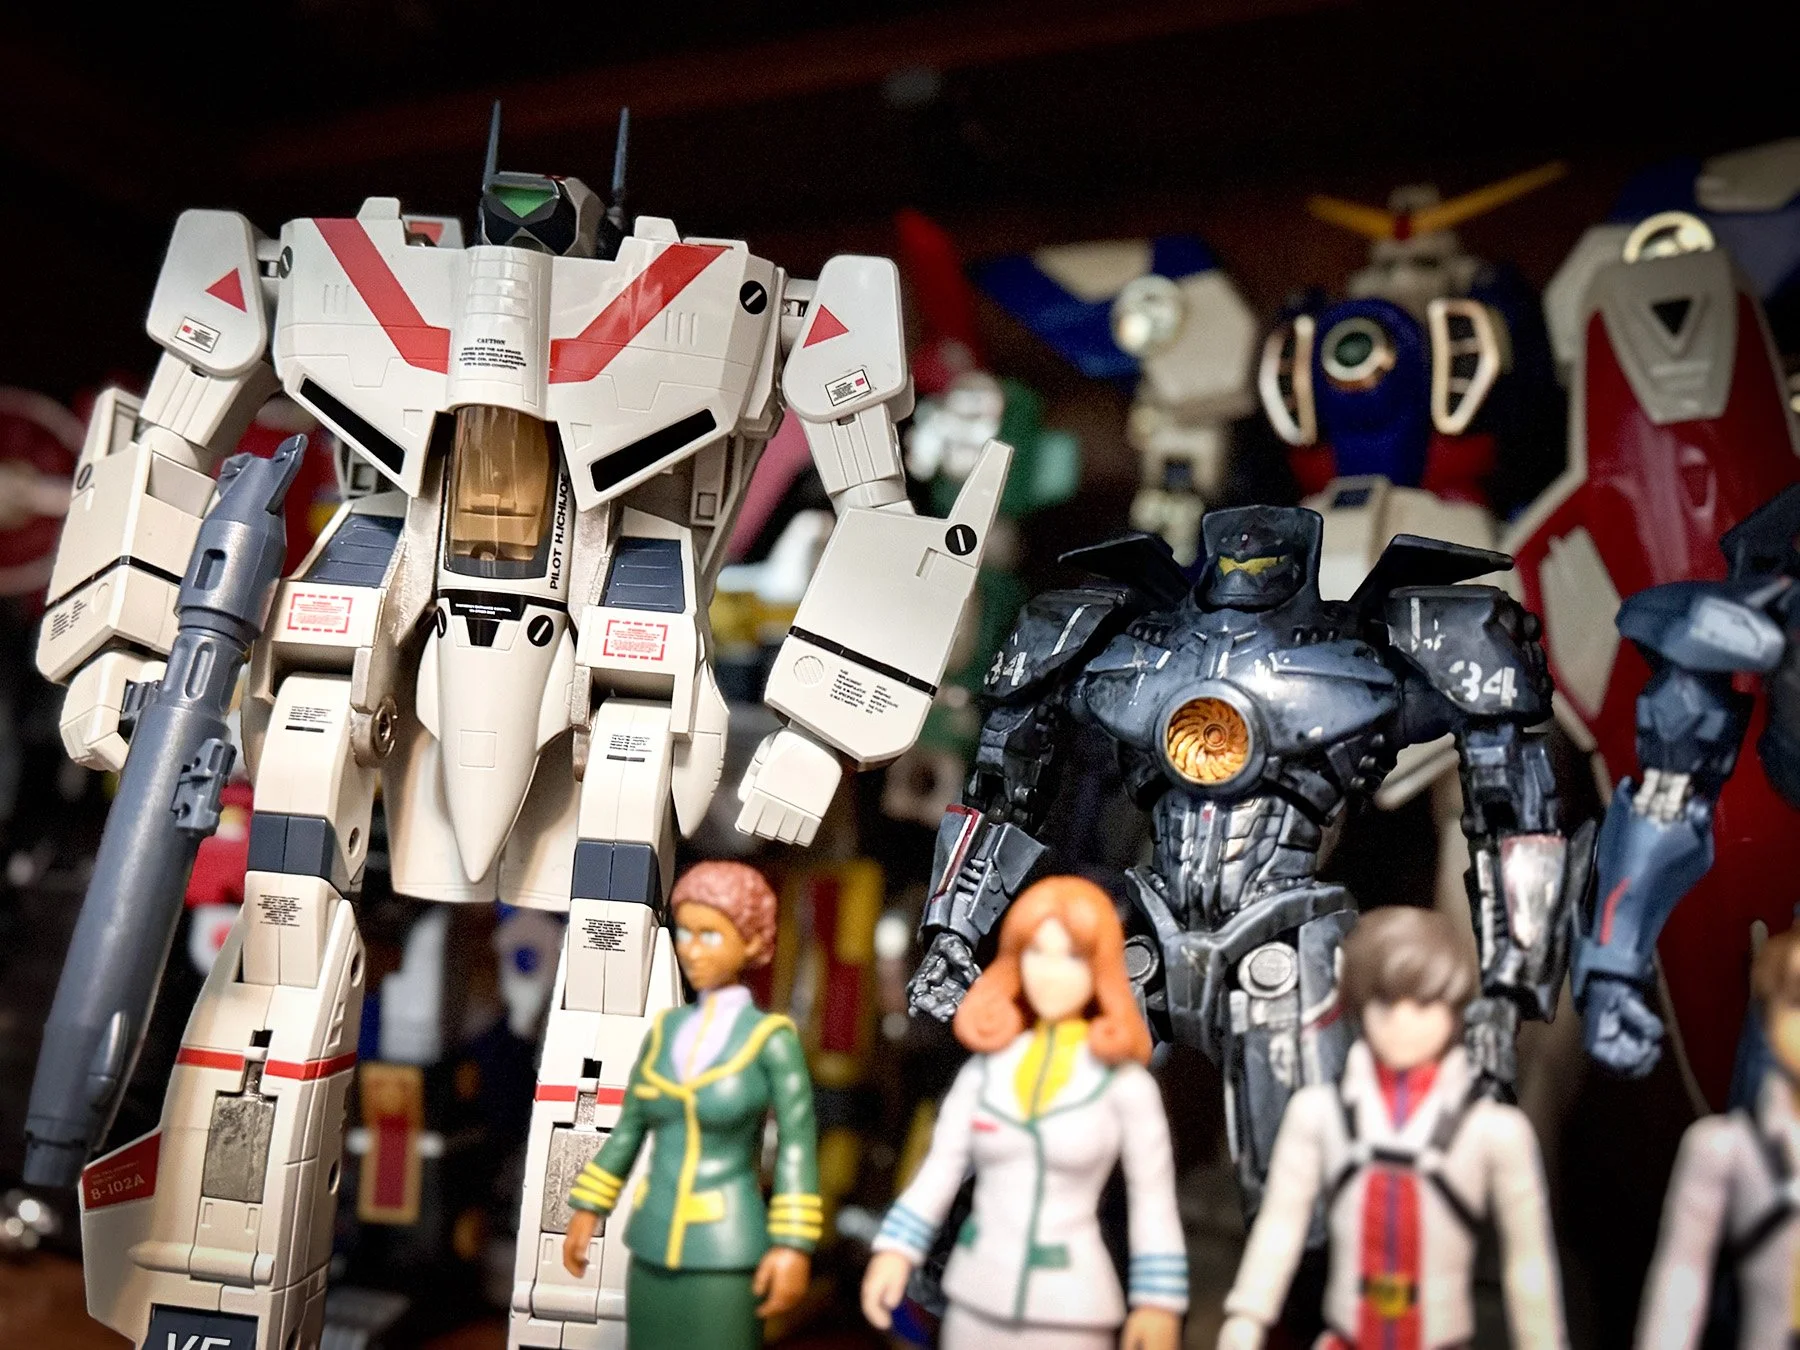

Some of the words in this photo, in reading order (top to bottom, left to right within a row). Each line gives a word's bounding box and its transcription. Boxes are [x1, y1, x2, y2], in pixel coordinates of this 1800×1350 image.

[549, 547, 562, 590] PILOT
[983, 651, 1027, 686] 34
[1447, 660, 1518, 707] 34
